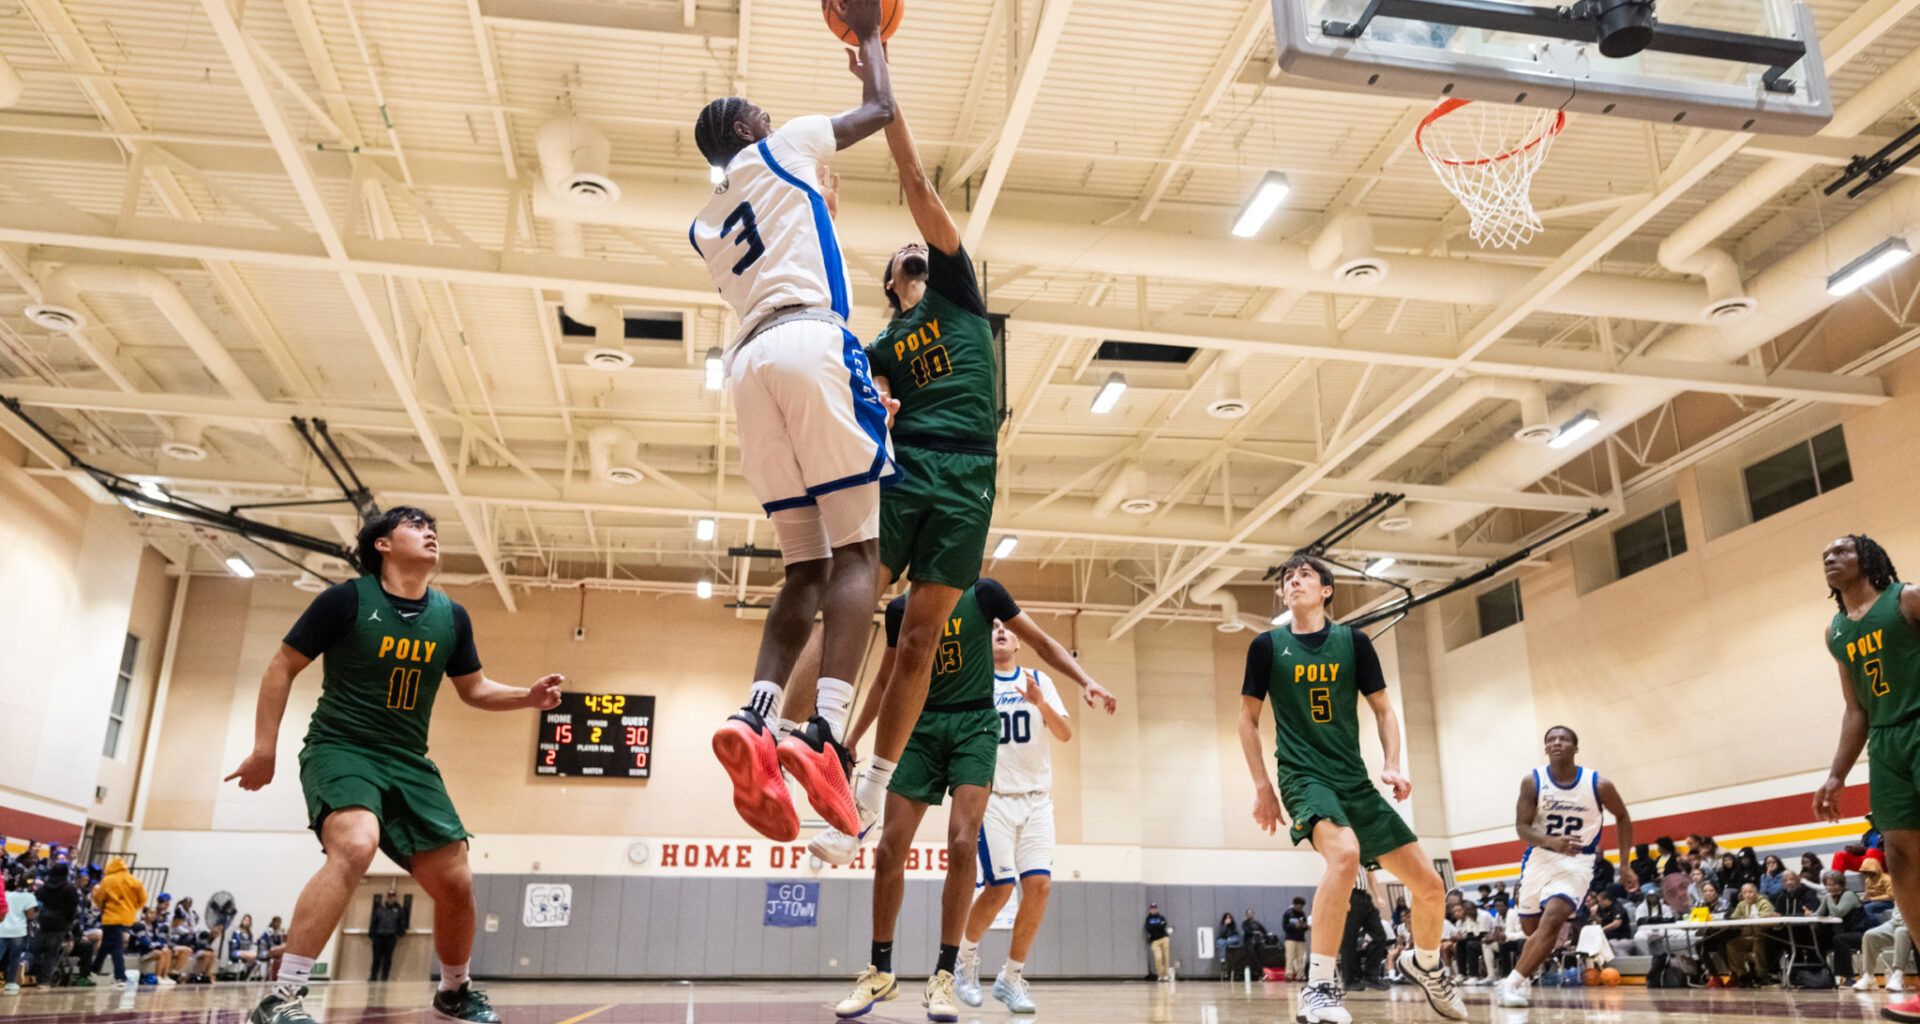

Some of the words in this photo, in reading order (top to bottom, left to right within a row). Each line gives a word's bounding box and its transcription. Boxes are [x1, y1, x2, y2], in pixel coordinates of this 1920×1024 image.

[720, 201, 765, 276] 3
[894, 318, 941, 361] POLY
[911, 344, 953, 388] 10
[378, 635, 437, 663] POLY
[1844, 628, 1883, 662] POLY
[1294, 663, 1339, 683] POLY
[1864, 658, 1890, 696] 2
[386, 667, 421, 710] 11
[585, 695, 625, 714] 4:52
[1310, 687, 1332, 723] 5
[547, 714, 572, 724] HOME
[621, 716, 649, 726] GUEST
[555, 725, 572, 744] 15
[590, 727, 602, 743] 2
[625, 727, 649, 746] 30
[545, 750, 556, 766] 2
[636, 752, 647, 768] 0
[1546, 814, 1584, 839] 22
[661, 844, 752, 868] HOME
[770, 845, 806, 869] OF
[779, 885, 805, 901] GO
[767, 900, 816, 917] J-TOWN
